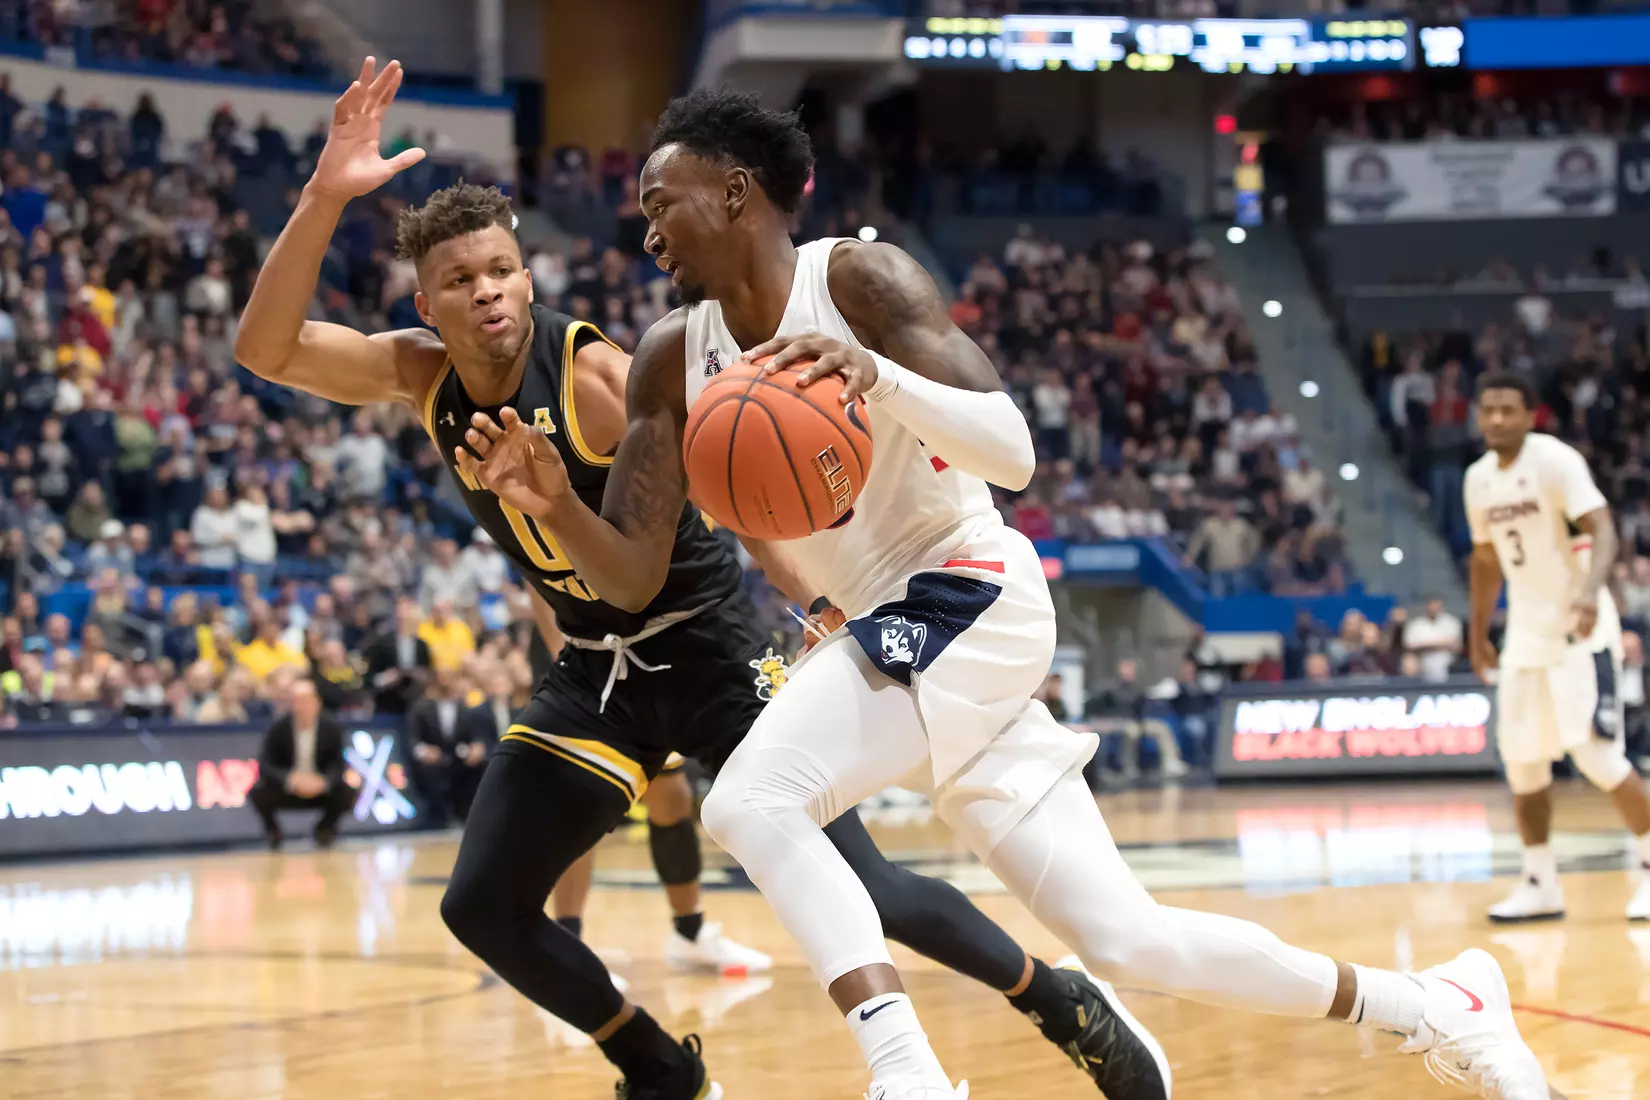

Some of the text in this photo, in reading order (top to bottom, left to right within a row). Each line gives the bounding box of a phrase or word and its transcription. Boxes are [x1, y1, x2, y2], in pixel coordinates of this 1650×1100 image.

[817, 444, 853, 515] ELITE
[1506, 529, 1526, 568] 3
[1235, 693, 1491, 733] NEW ENGLAND
[1233, 725, 1486, 761] BLACK WOLVES
